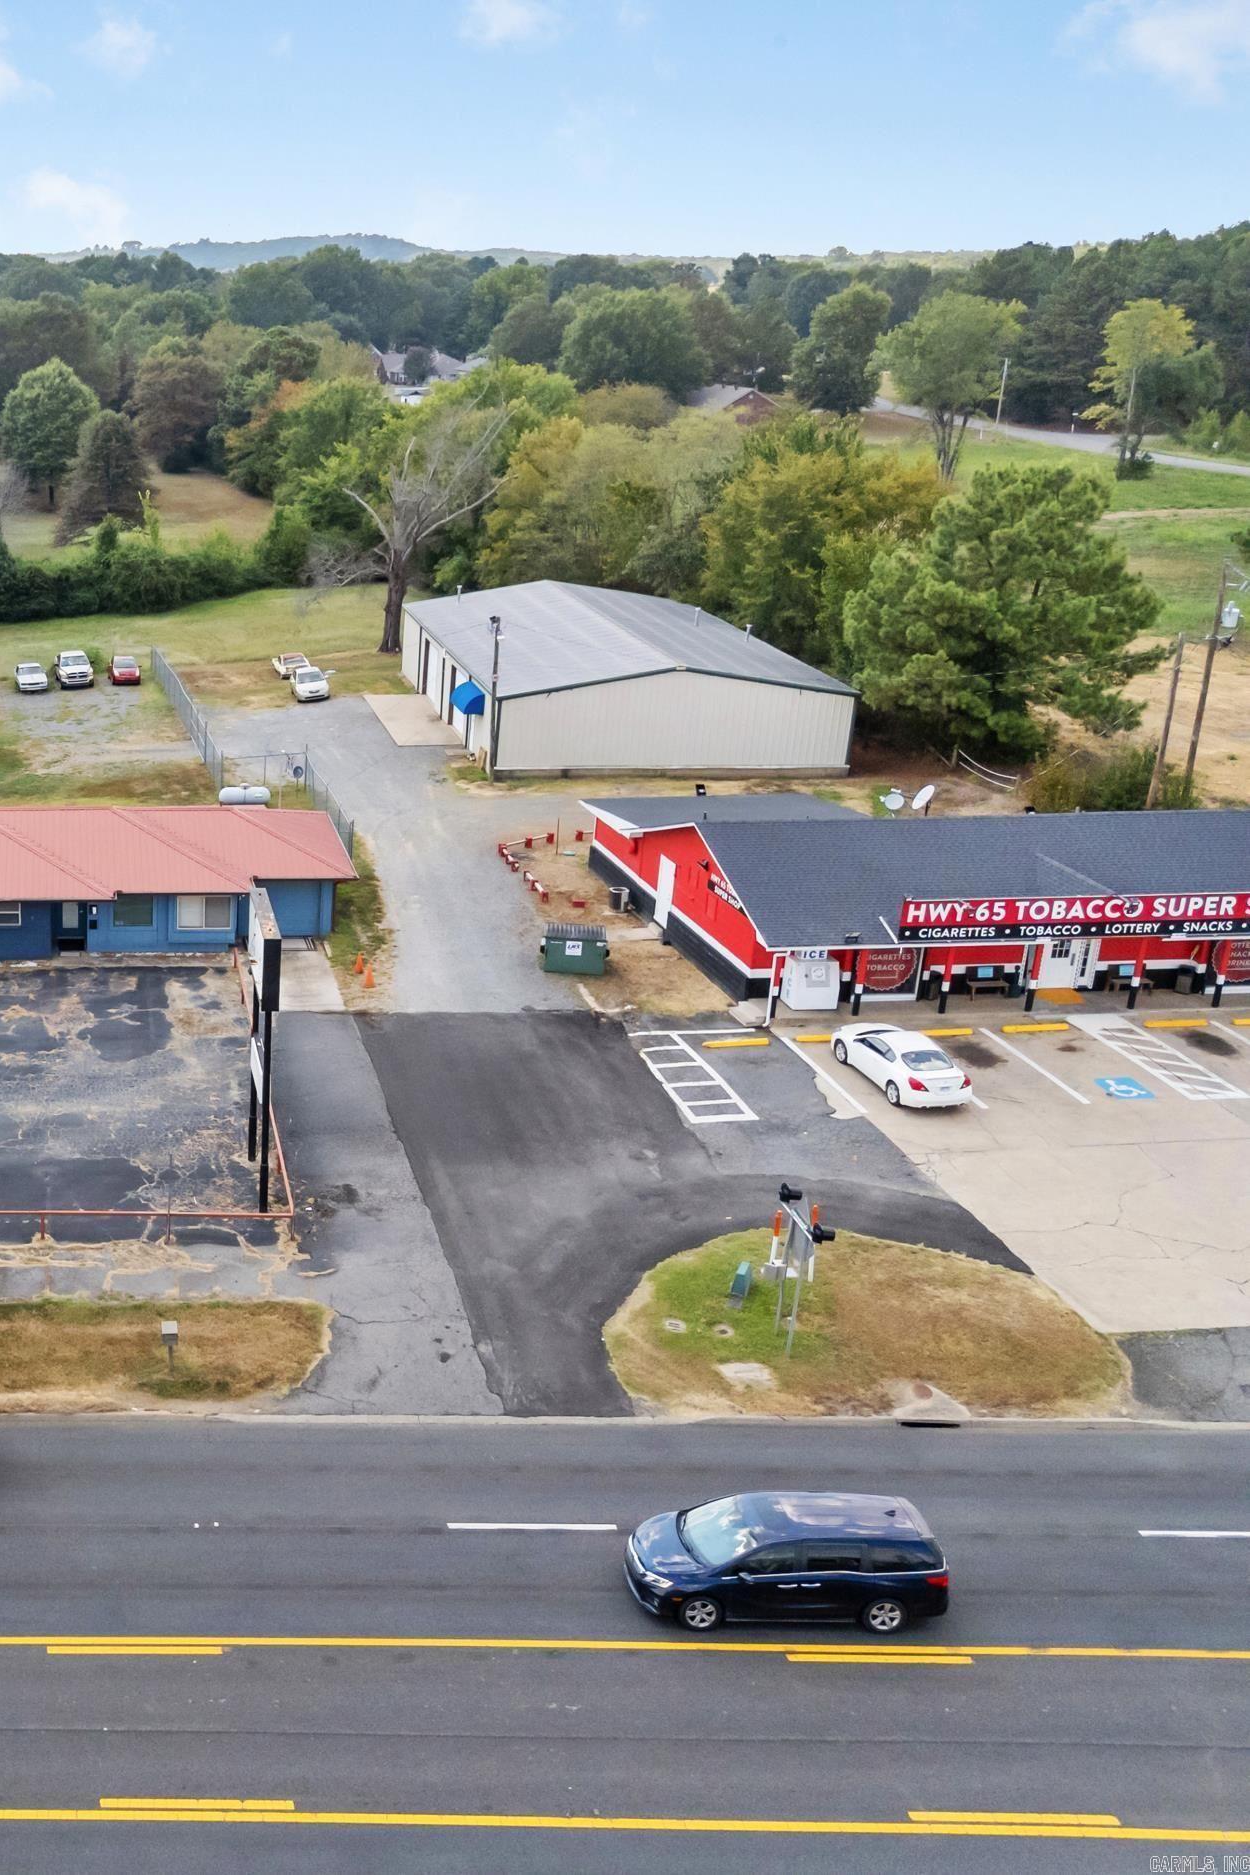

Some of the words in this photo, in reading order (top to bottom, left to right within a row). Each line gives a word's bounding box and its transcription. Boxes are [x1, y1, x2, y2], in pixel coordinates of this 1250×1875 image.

[1015, 898, 1144, 921] TOBACCO
[1151, 896, 1237, 918] SUPER
[918, 927, 996, 938] CIGARETTES
[1019, 924, 1082, 937] TOBACCO
[1104, 923, 1161, 934] LOTTERY
[1182, 921, 1234, 932] SNACKS
[803, 950, 826, 959] ICE
[869, 953, 911, 961] IGARETTES
